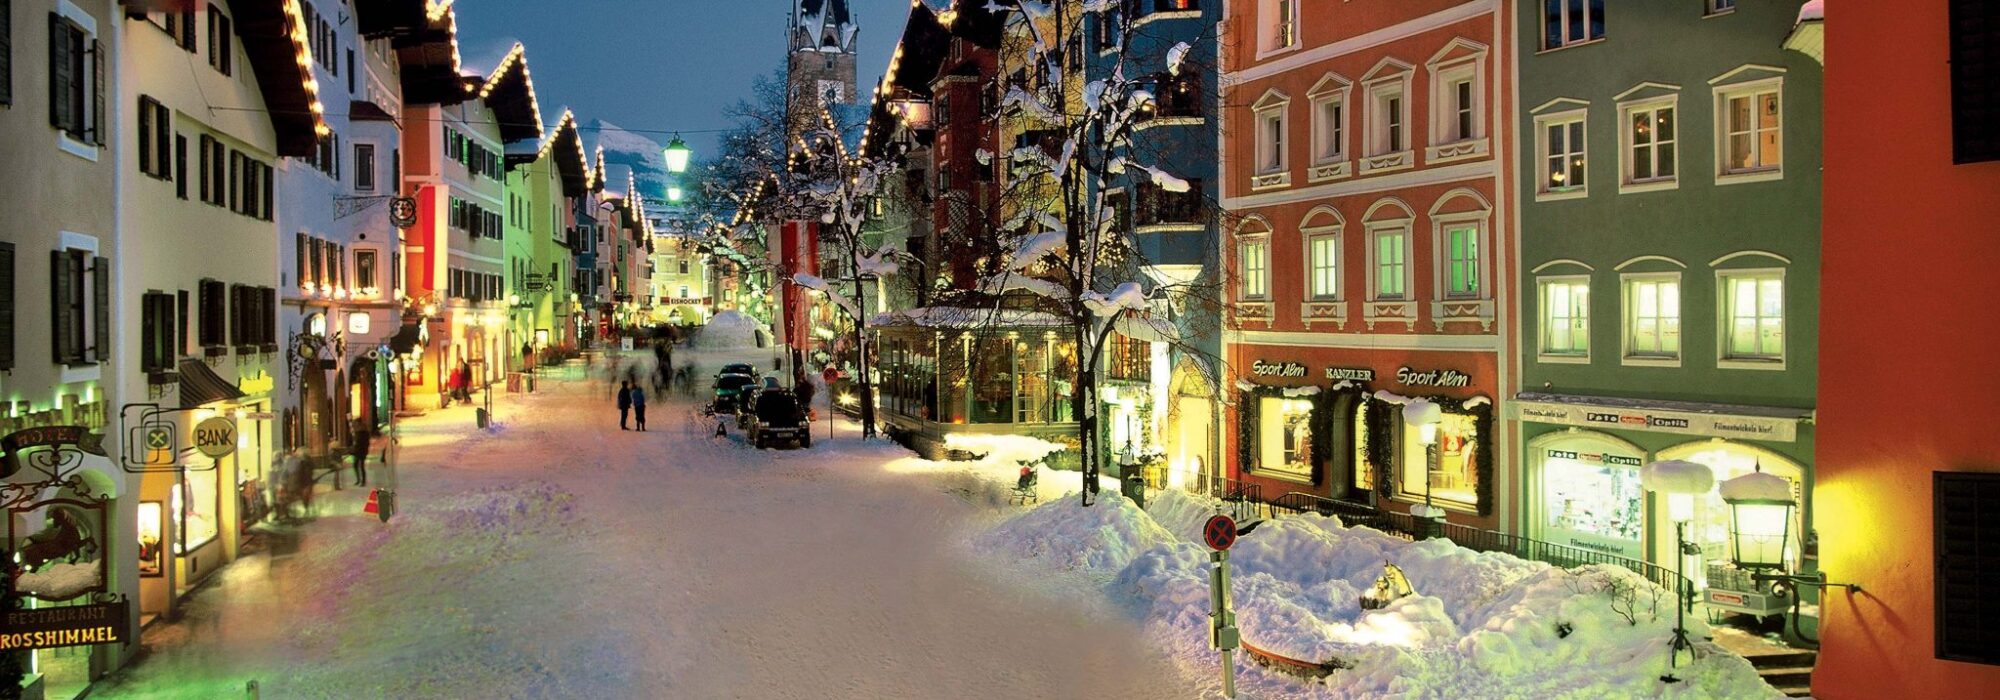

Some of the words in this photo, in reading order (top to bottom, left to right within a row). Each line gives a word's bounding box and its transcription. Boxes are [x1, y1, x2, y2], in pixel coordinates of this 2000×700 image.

[1252, 359, 1280, 377] Sport
[1281, 363, 1305, 377] Alm
[1326, 368, 1371, 381] KANZLER
[1396, 367, 1436, 388] Sport
[1435, 370, 1468, 387] Alm
[1588, 413, 1617, 422] Foto
[1654, 418, 1688, 428] Optik
[197, 429, 233, 446] BANK
[1549, 450, 1576, 459] Foto
[1611, 456, 1640, 465] Optik
[8, 607, 107, 624] RESTAURANT
[0, 626, 117, 649] ROSSHIMMEL
